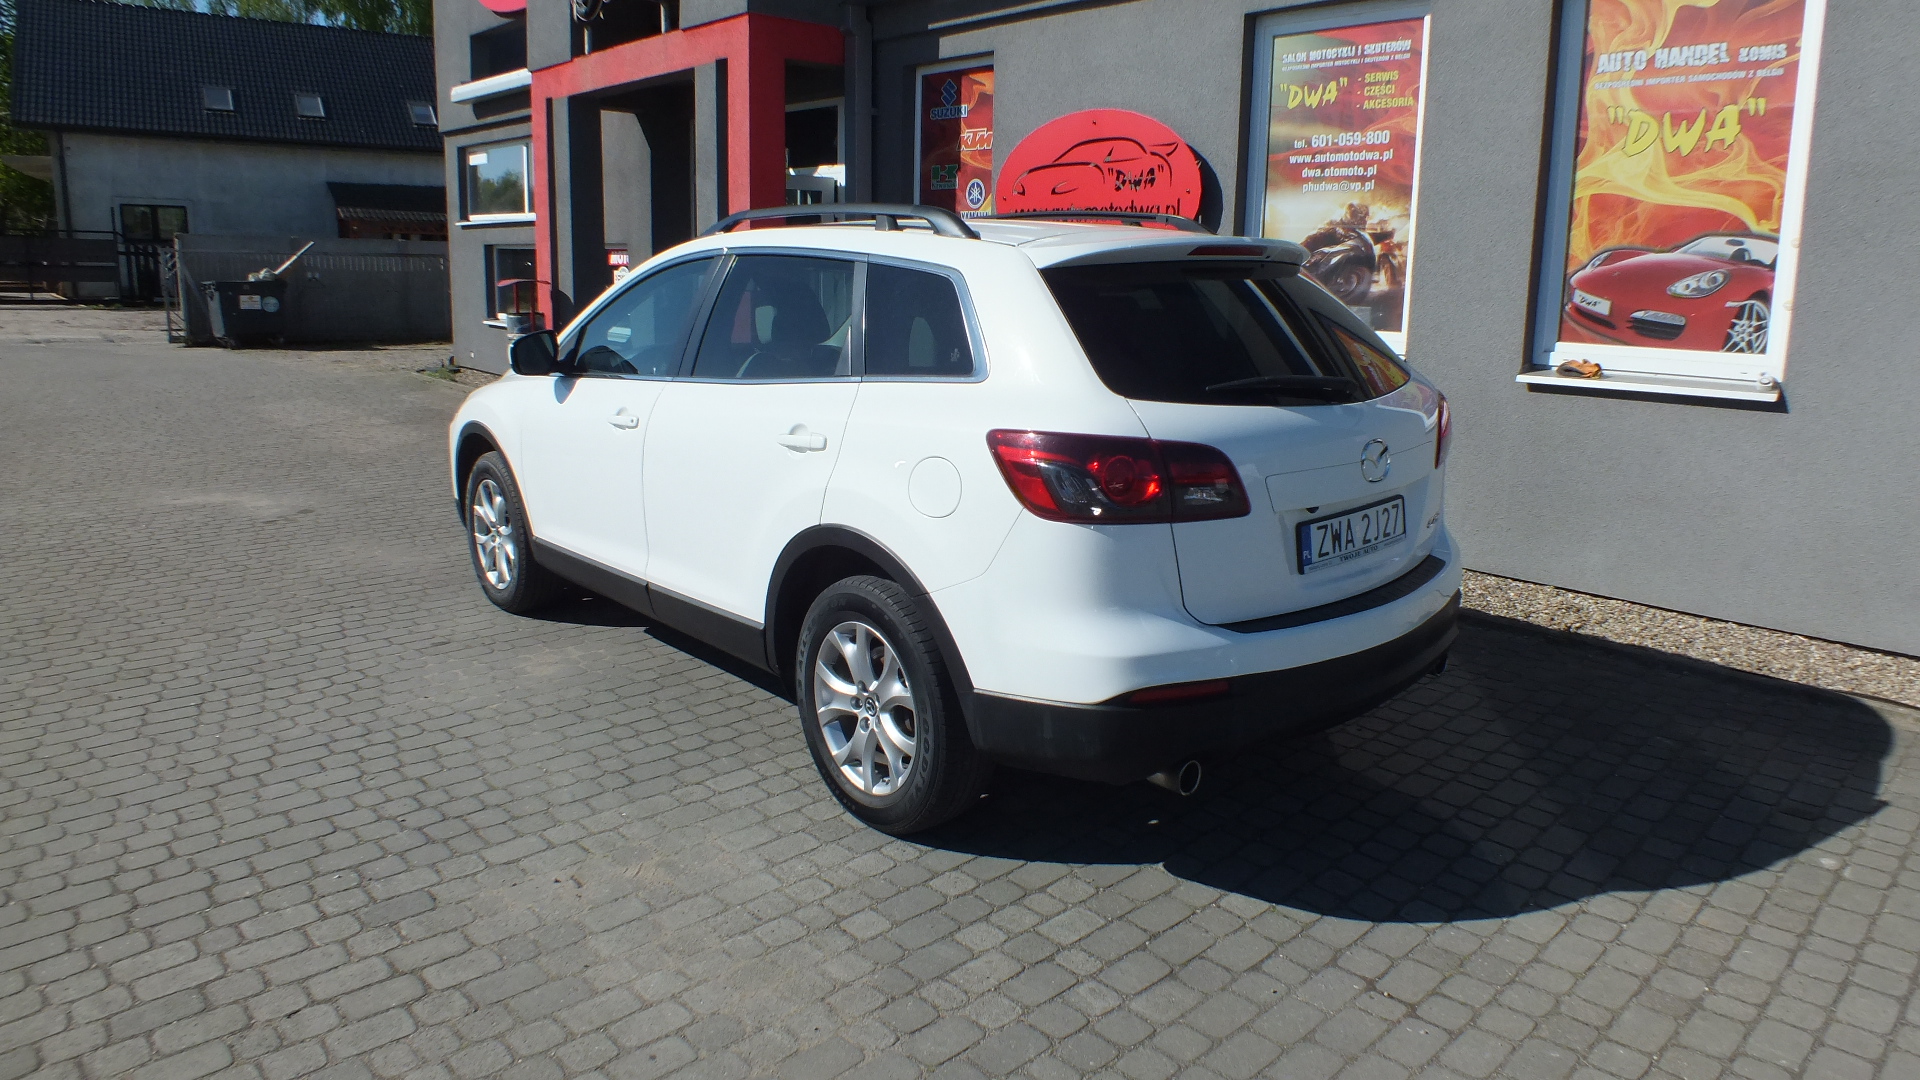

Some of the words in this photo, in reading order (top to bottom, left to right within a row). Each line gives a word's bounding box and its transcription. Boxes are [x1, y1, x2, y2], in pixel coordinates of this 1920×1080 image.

[1282, 52, 1306, 64] SALON
[1309, 45, 1355, 61] MOTOCYKLI
[1596, 50, 1647, 75] AUTO
[1654, 42, 1730, 70] HANDEL
[1364, 70, 1399, 83] SERWIS
[1280, 77, 1348, 109] "DWA"
[930, 105, 967, 120] SUZUKI
[1363, 96, 1415, 110] AKCESORIA
[1607, 97, 1767, 157] "DWA"
[957, 128, 993, 151] KTM
[1294, 139, 1308, 149] tel.
[1311, 130, 1390, 148] 601-059-800
[1289, 148, 1394, 164] www.automotodwa.pl
[1302, 164, 1377, 178] dwa.otomoto.pl
[1302, 179, 1375, 194] phudwa@vp.pl
[1316, 518, 1355, 559] ZWA
[1362, 503, 1400, 545] 2J27
